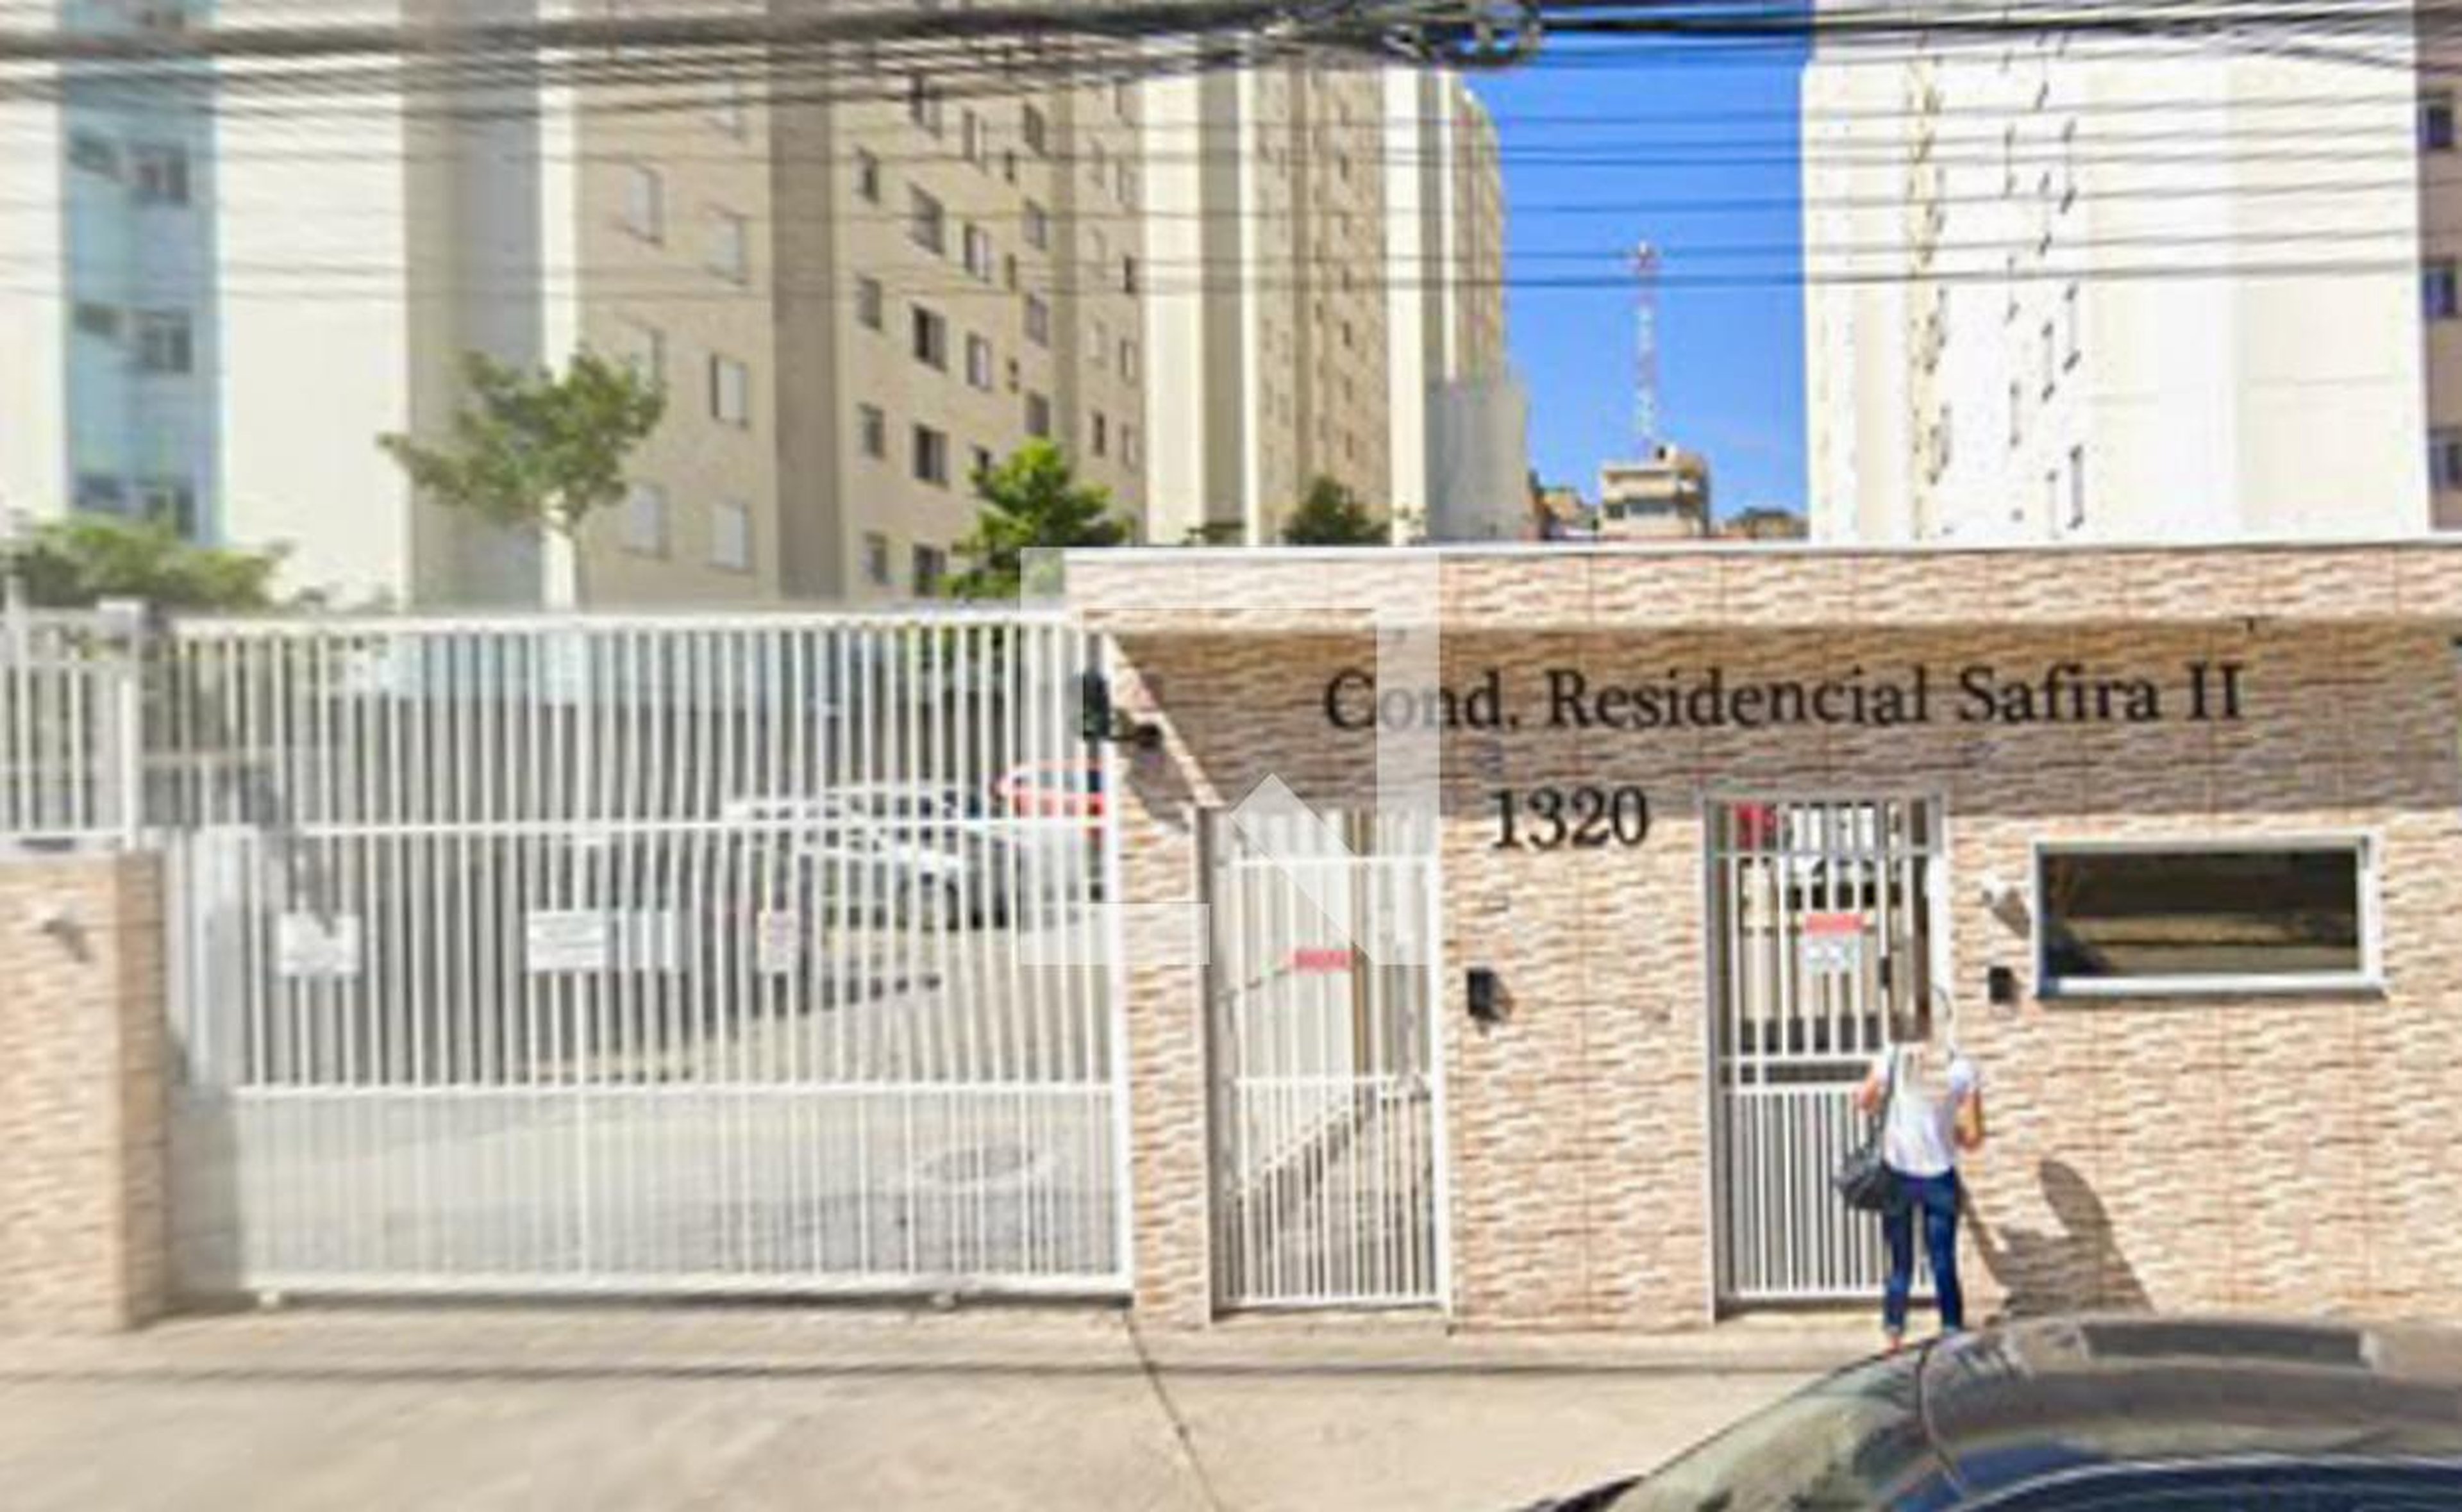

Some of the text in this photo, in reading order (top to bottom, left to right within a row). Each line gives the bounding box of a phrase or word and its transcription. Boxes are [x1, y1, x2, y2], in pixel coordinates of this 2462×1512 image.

[1324, 661, 2245, 730] Cond. Residencial Safira II
[1489, 786, 1650, 849] 1320
